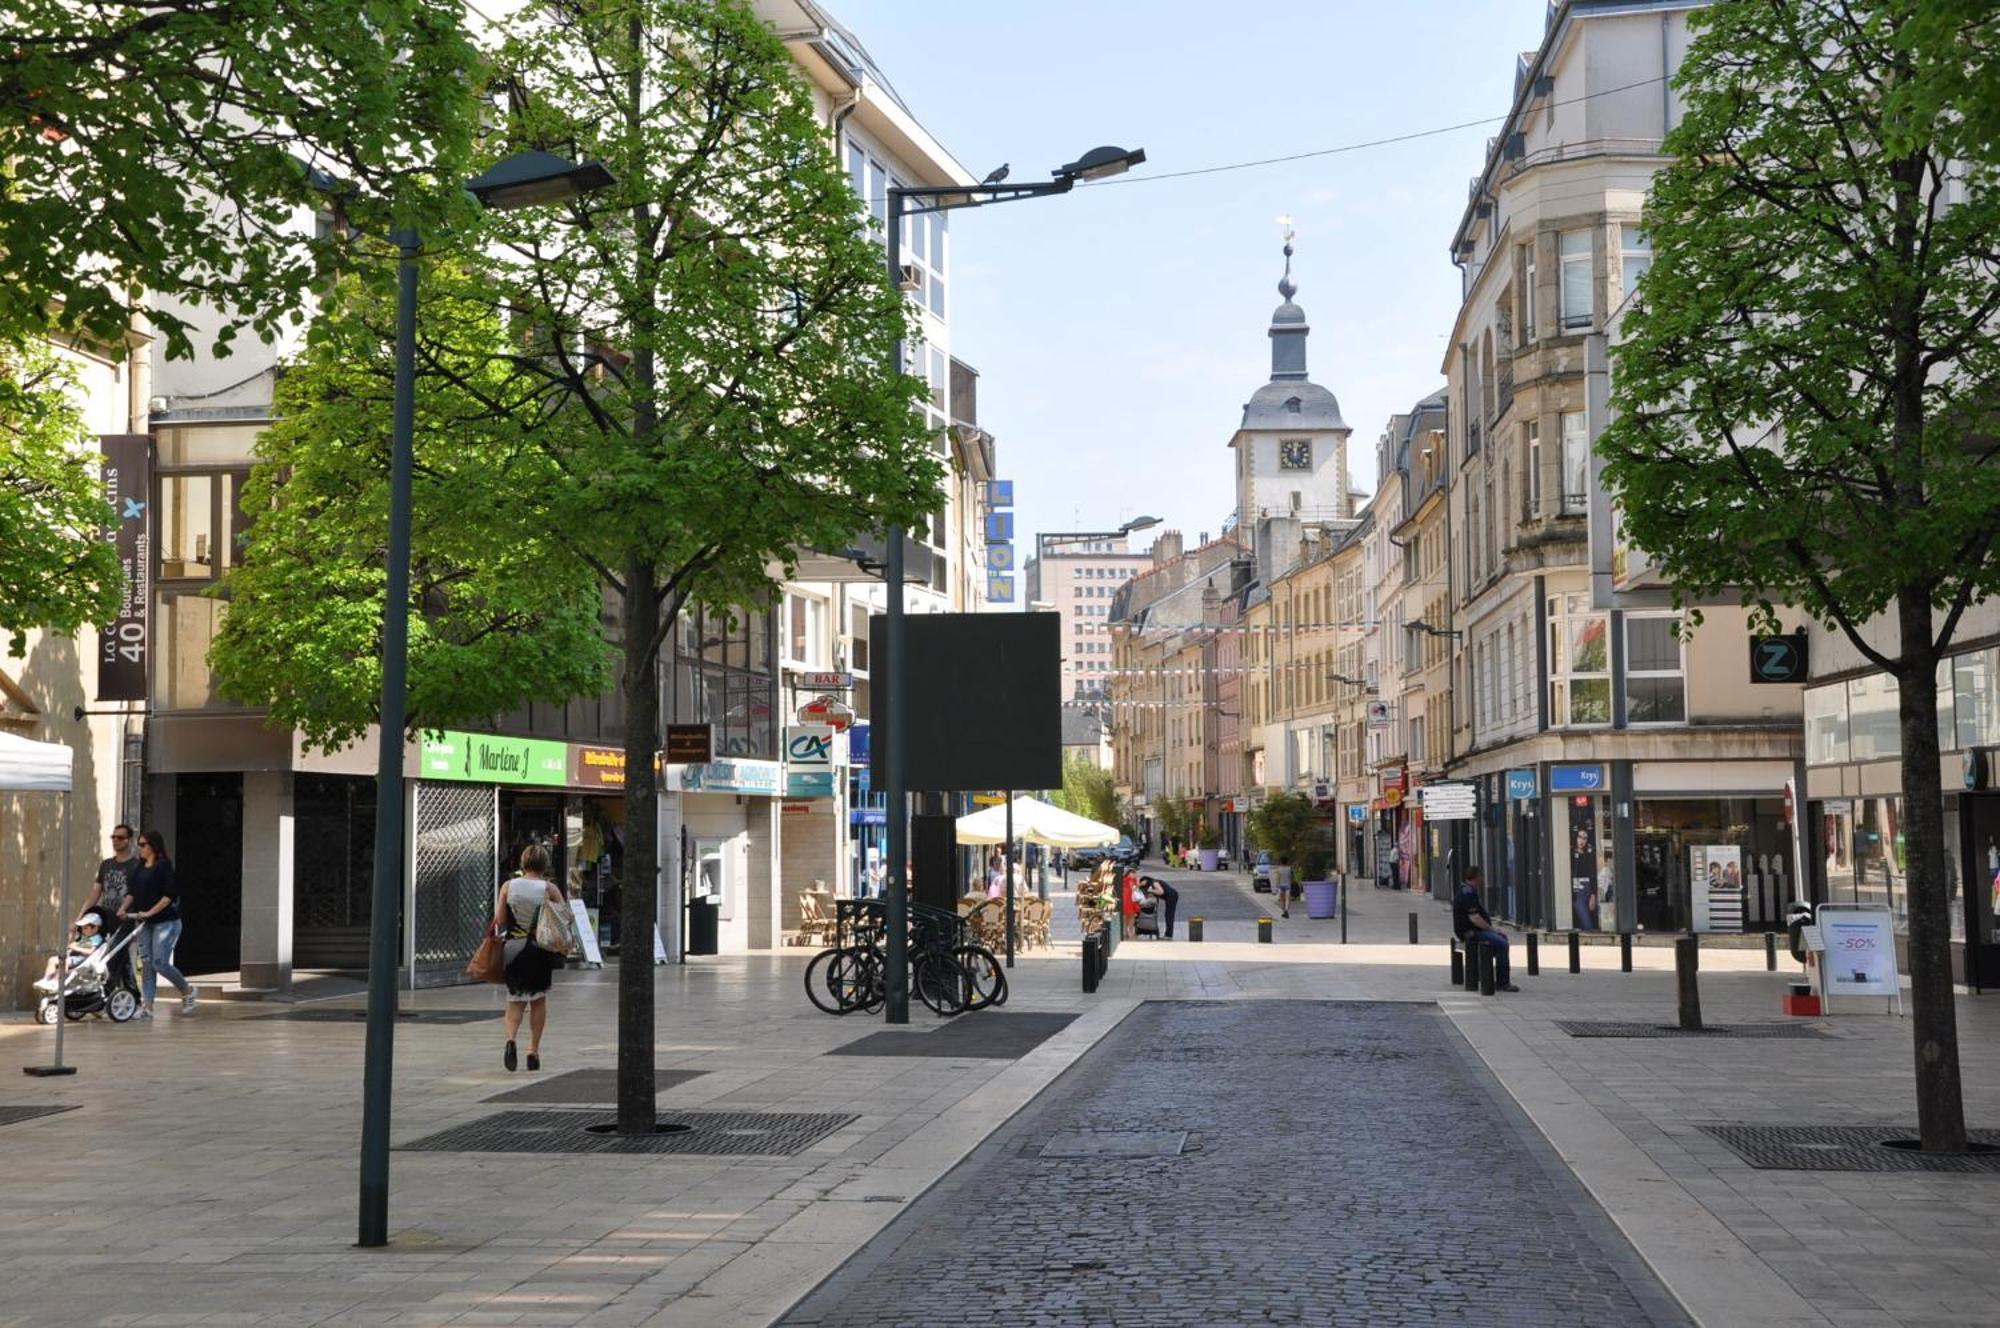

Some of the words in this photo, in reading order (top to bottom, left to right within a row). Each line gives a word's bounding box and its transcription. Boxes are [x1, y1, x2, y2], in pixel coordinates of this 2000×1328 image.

[133, 533, 146, 604] Restaurants
[133, 608, 145, 618] &
[119, 623, 144, 663] 40
[1762, 645, 1790, 674] Z
[814, 674, 840, 684] BAR
[1510, 779, 1532, 791] Krys
[1836, 937, 1876, 949] -50%
